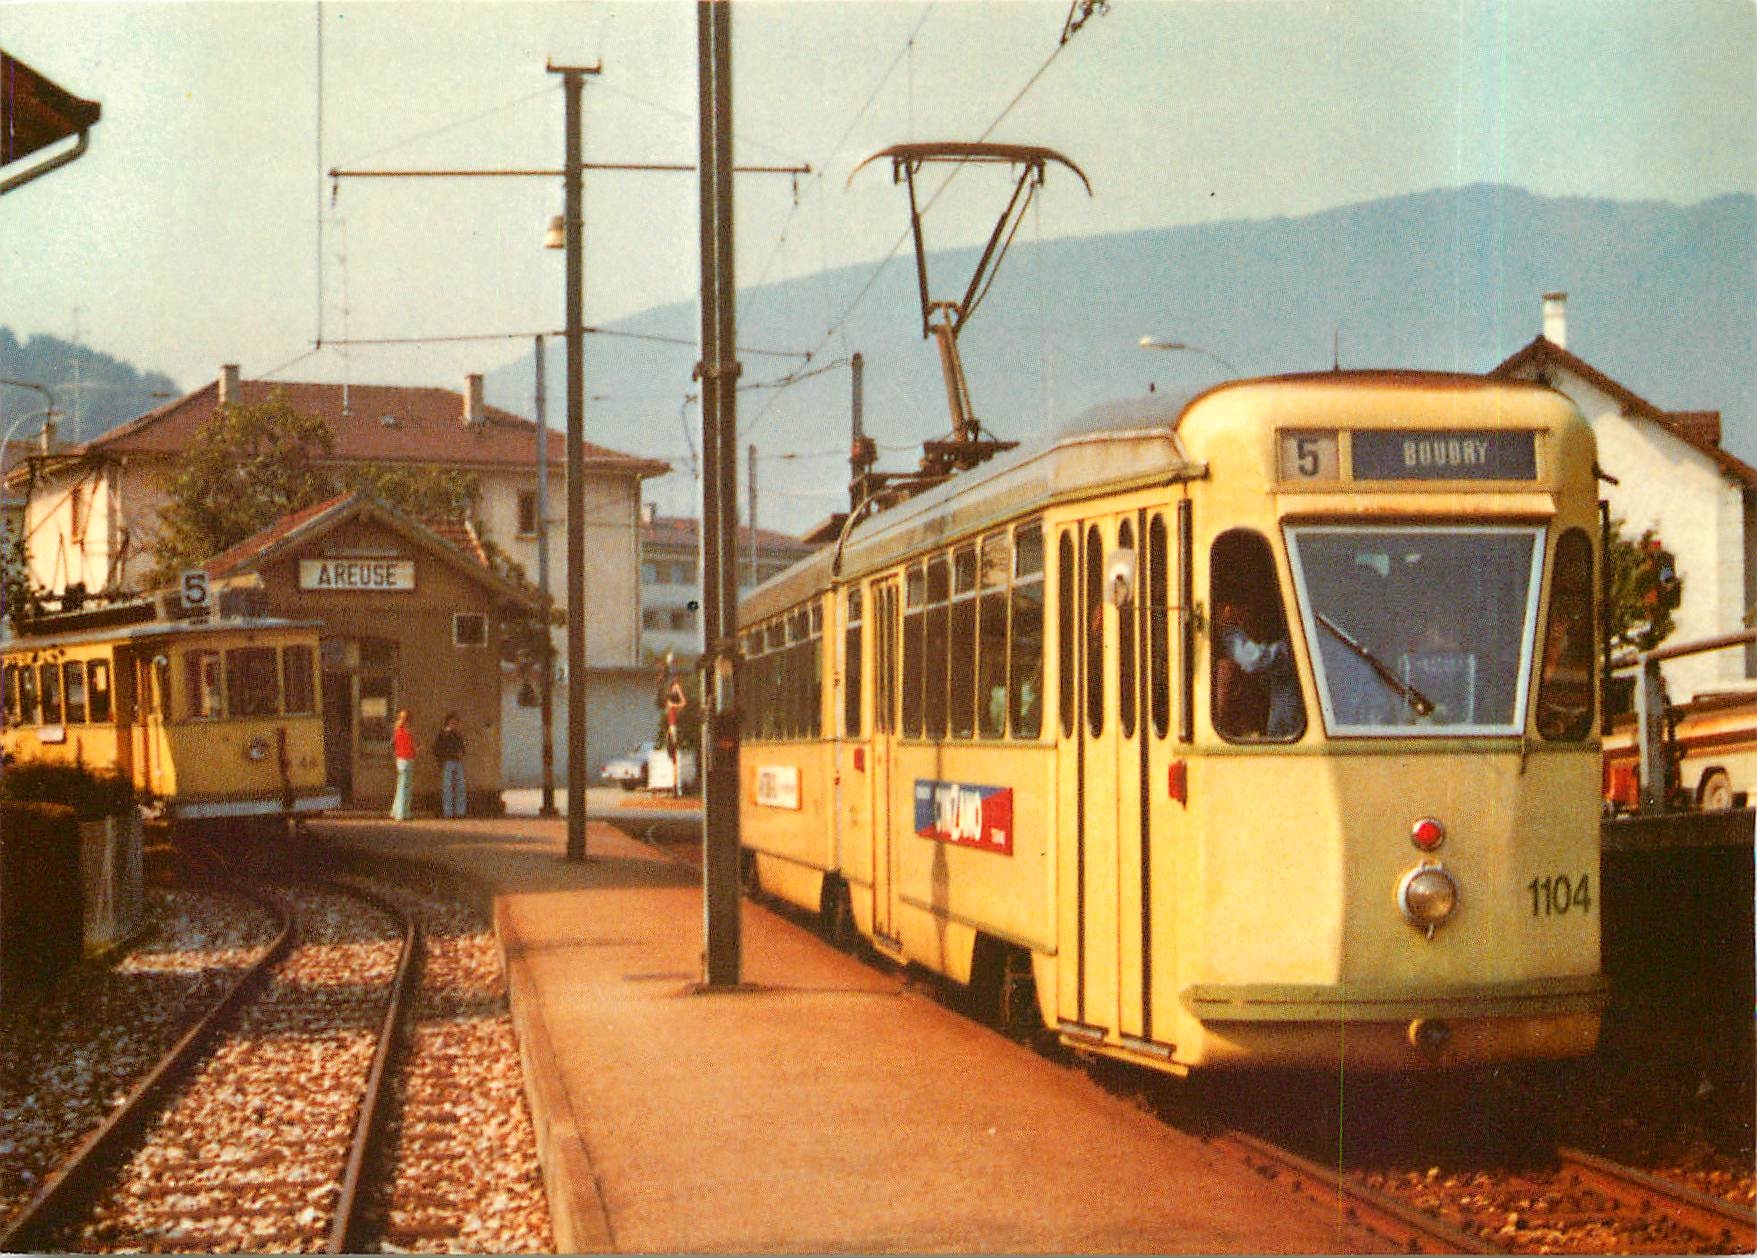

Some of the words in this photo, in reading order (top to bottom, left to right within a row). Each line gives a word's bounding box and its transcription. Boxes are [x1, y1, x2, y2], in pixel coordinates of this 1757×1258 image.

[1296, 437, 1320, 476] 5
[1403, 440, 1488, 466] BOUDRY
[185, 574, 206, 603] 5
[318, 562, 398, 586] AREUSE
[1528, 873, 1592, 916] 1104
